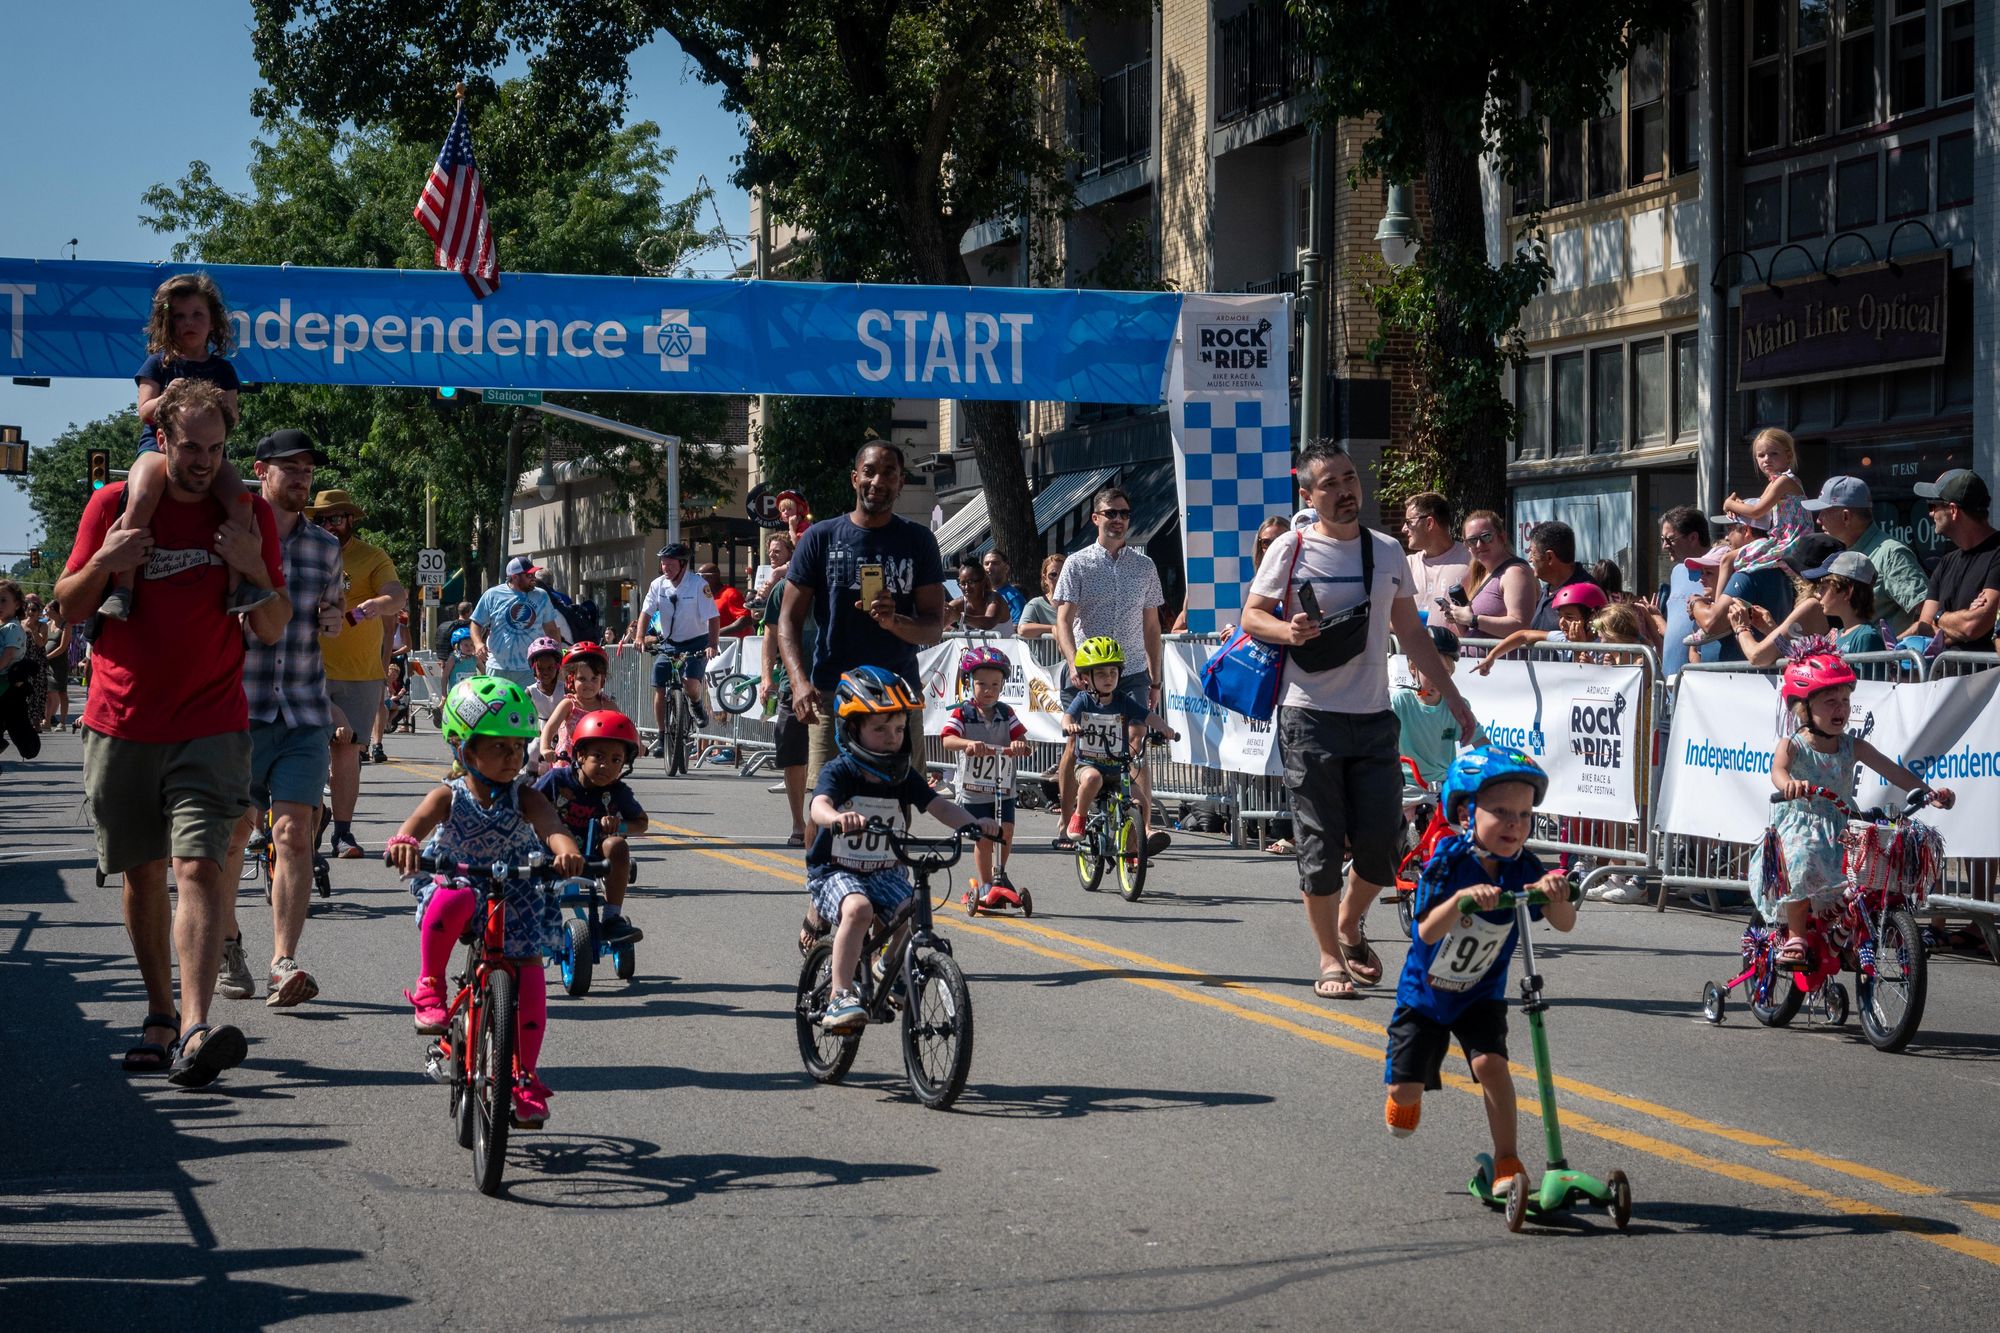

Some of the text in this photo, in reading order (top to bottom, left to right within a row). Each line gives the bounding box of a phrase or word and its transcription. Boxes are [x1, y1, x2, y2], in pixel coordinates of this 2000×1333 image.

[230, 298, 627, 364] ndependence
[1746, 293, 1941, 361] Main Line Optical
[1201, 326, 1267, 347] ROCK
[857, 308, 1034, 384] START
[1215, 349, 1268, 369] RIDE
[487, 389, 524, 401] Station
[1900, 462, 1920, 476] EAST
[763, 495, 778, 515] P
[755, 516, 781, 527] PARKIN
[150, 560, 187, 575] Ballpark
[421, 553, 443, 570] 30
[420, 573, 443, 584] WEST
[1247, 639, 1279, 660] EPUBLIC
[1248, 650, 1272, 666] BANK
[1001, 685, 1025, 698] AINTING
[1586, 686, 1610, 695] ARDMORE
[1572, 703, 1621, 735] ROCK
[1583, 737, 1621, 768] RIDE
[1582, 773, 1592, 783] BIKE
[1593, 774, 1607, 784] RACE
[1578, 785, 1616, 797] MUSIC FESTIVAL
[1451, 936, 1498, 974] 92
